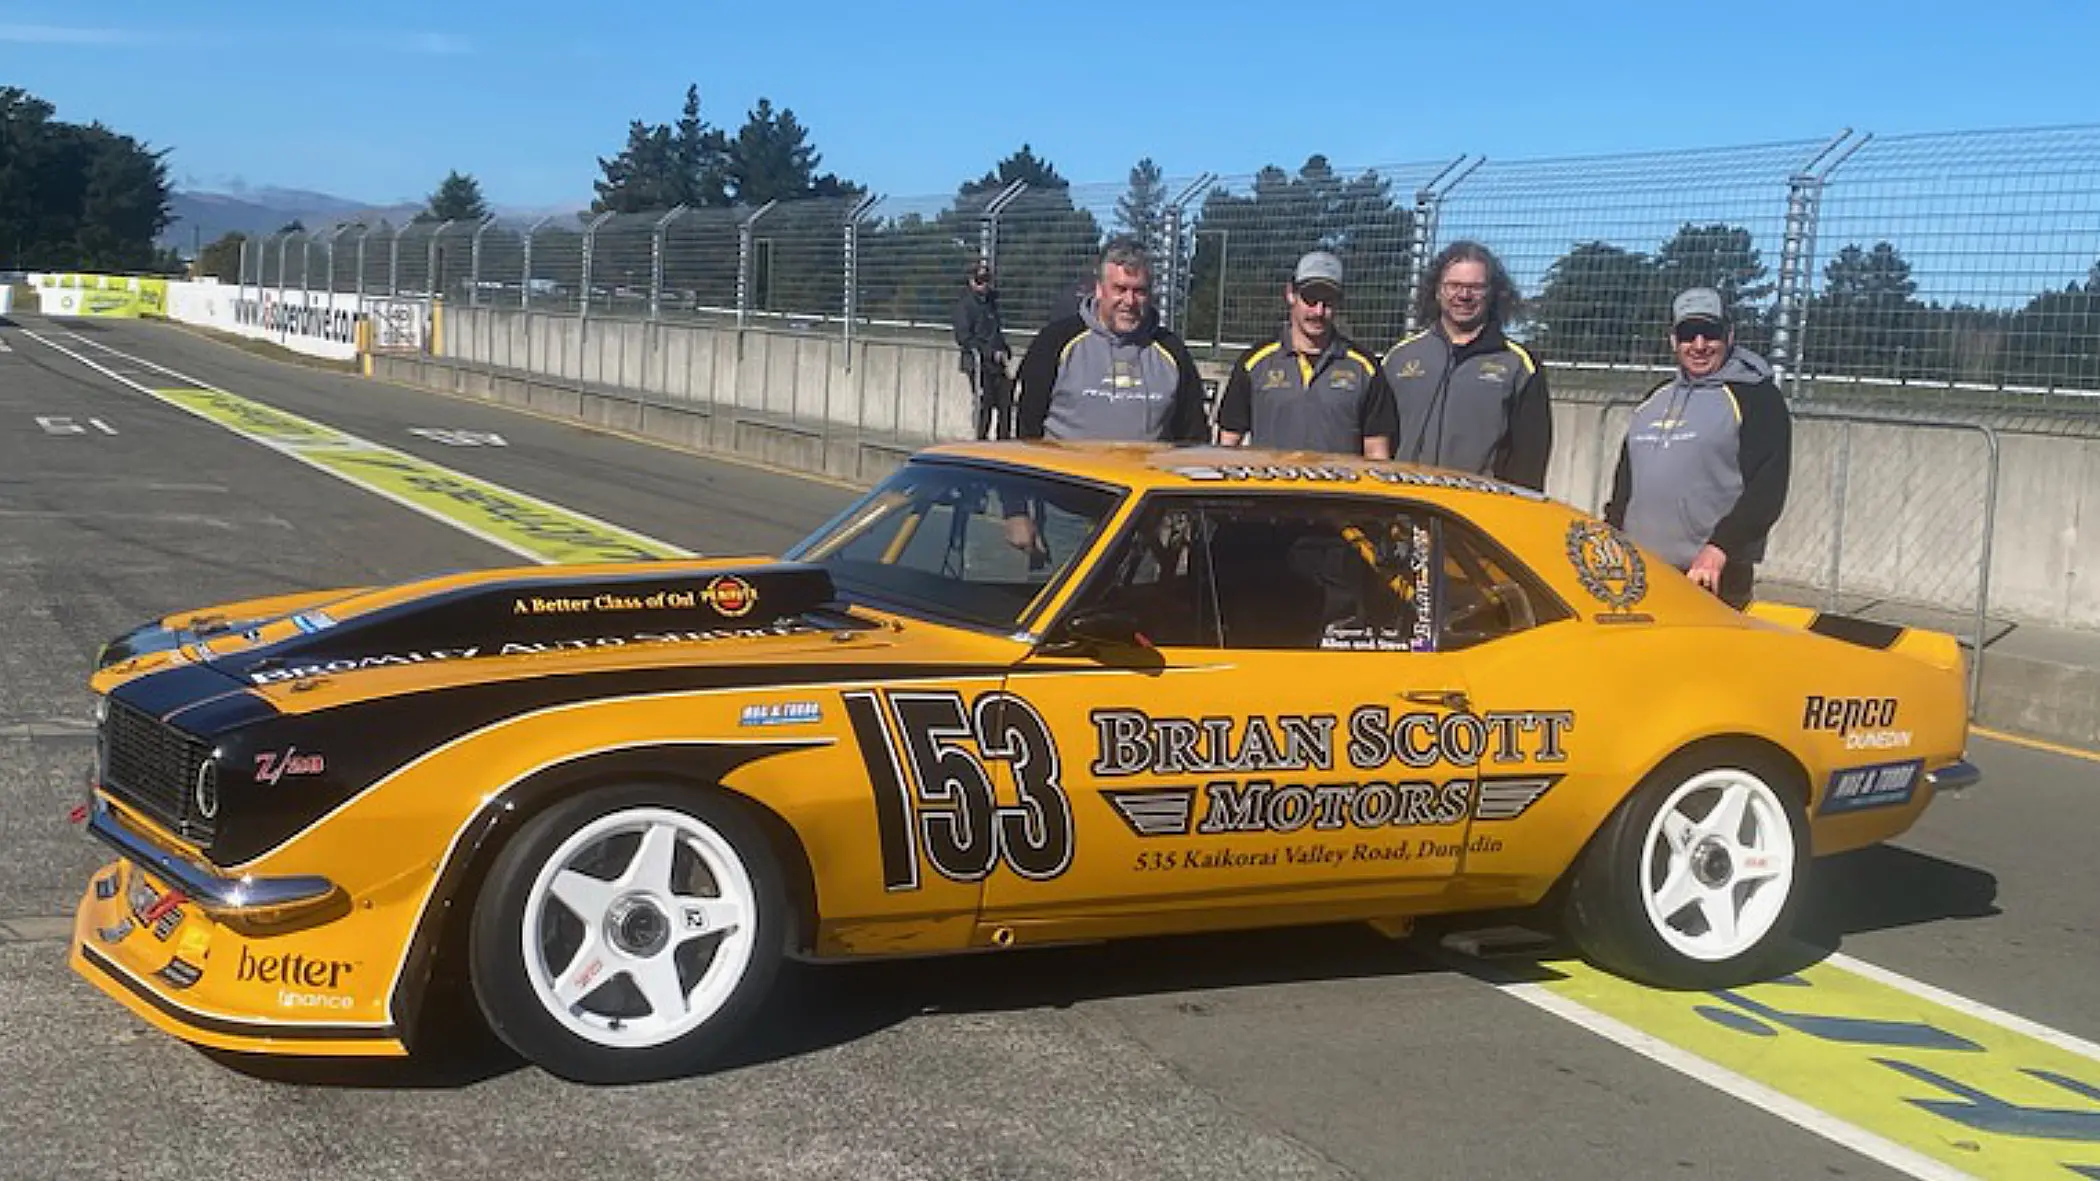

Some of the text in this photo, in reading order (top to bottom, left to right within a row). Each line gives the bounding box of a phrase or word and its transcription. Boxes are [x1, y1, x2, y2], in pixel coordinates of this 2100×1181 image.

[513, 591, 695, 614] A Better Class of Oil
[1090, 704, 1575, 776] BRIAN SCOTT
[1846, 731, 1912, 750] DUNEDIN
[840, 690, 1075, 892] 153
[1198, 778, 1475, 836] MOTORS
[1133, 850, 1177, 872] 535
[1183, 847, 1279, 869] Kaikorai
[1285, 843, 1344, 869] Valley
[1352, 839, 1409, 862] Road,
[236, 944, 353, 989] better
